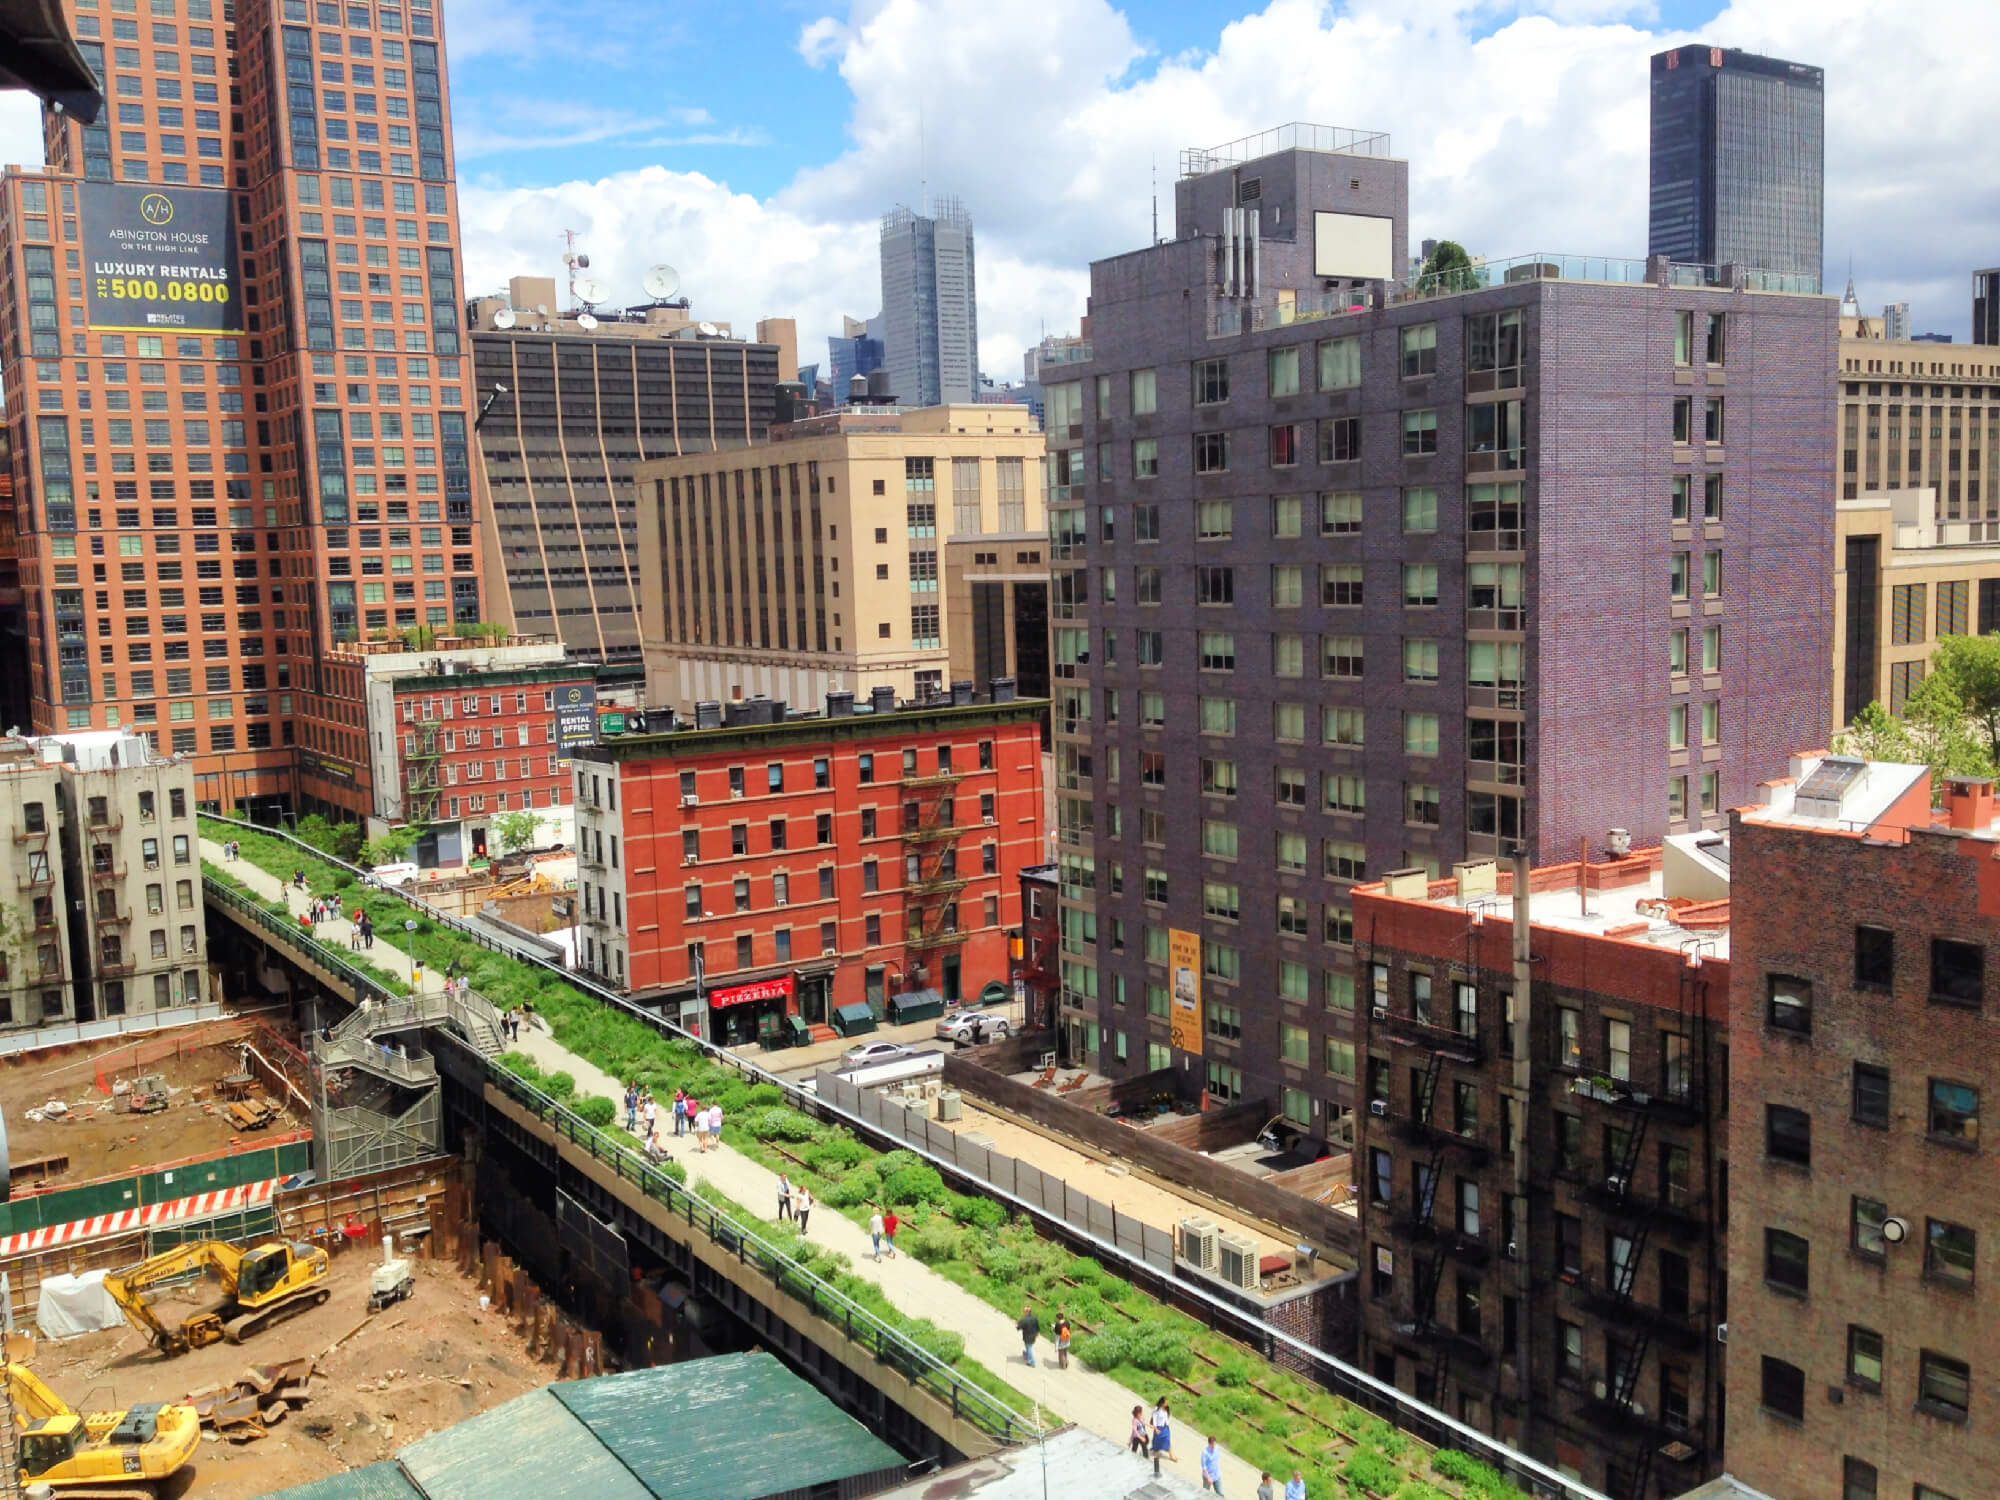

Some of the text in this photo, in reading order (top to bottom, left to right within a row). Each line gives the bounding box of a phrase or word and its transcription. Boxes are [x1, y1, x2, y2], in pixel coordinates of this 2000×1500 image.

[109, 229, 209, 244] ABINGTON HOUSE
[136, 243, 152, 251] THE
[179, 246, 199, 254] LINE
[95, 262, 228, 279] LUXURY RENTALS
[96, 278, 229, 303] 212 500.0800
[560, 715, 591, 725] RENTAL
[562, 723, 590, 733] OFFICE
[721, 986, 785, 1005] PIZZERIA
